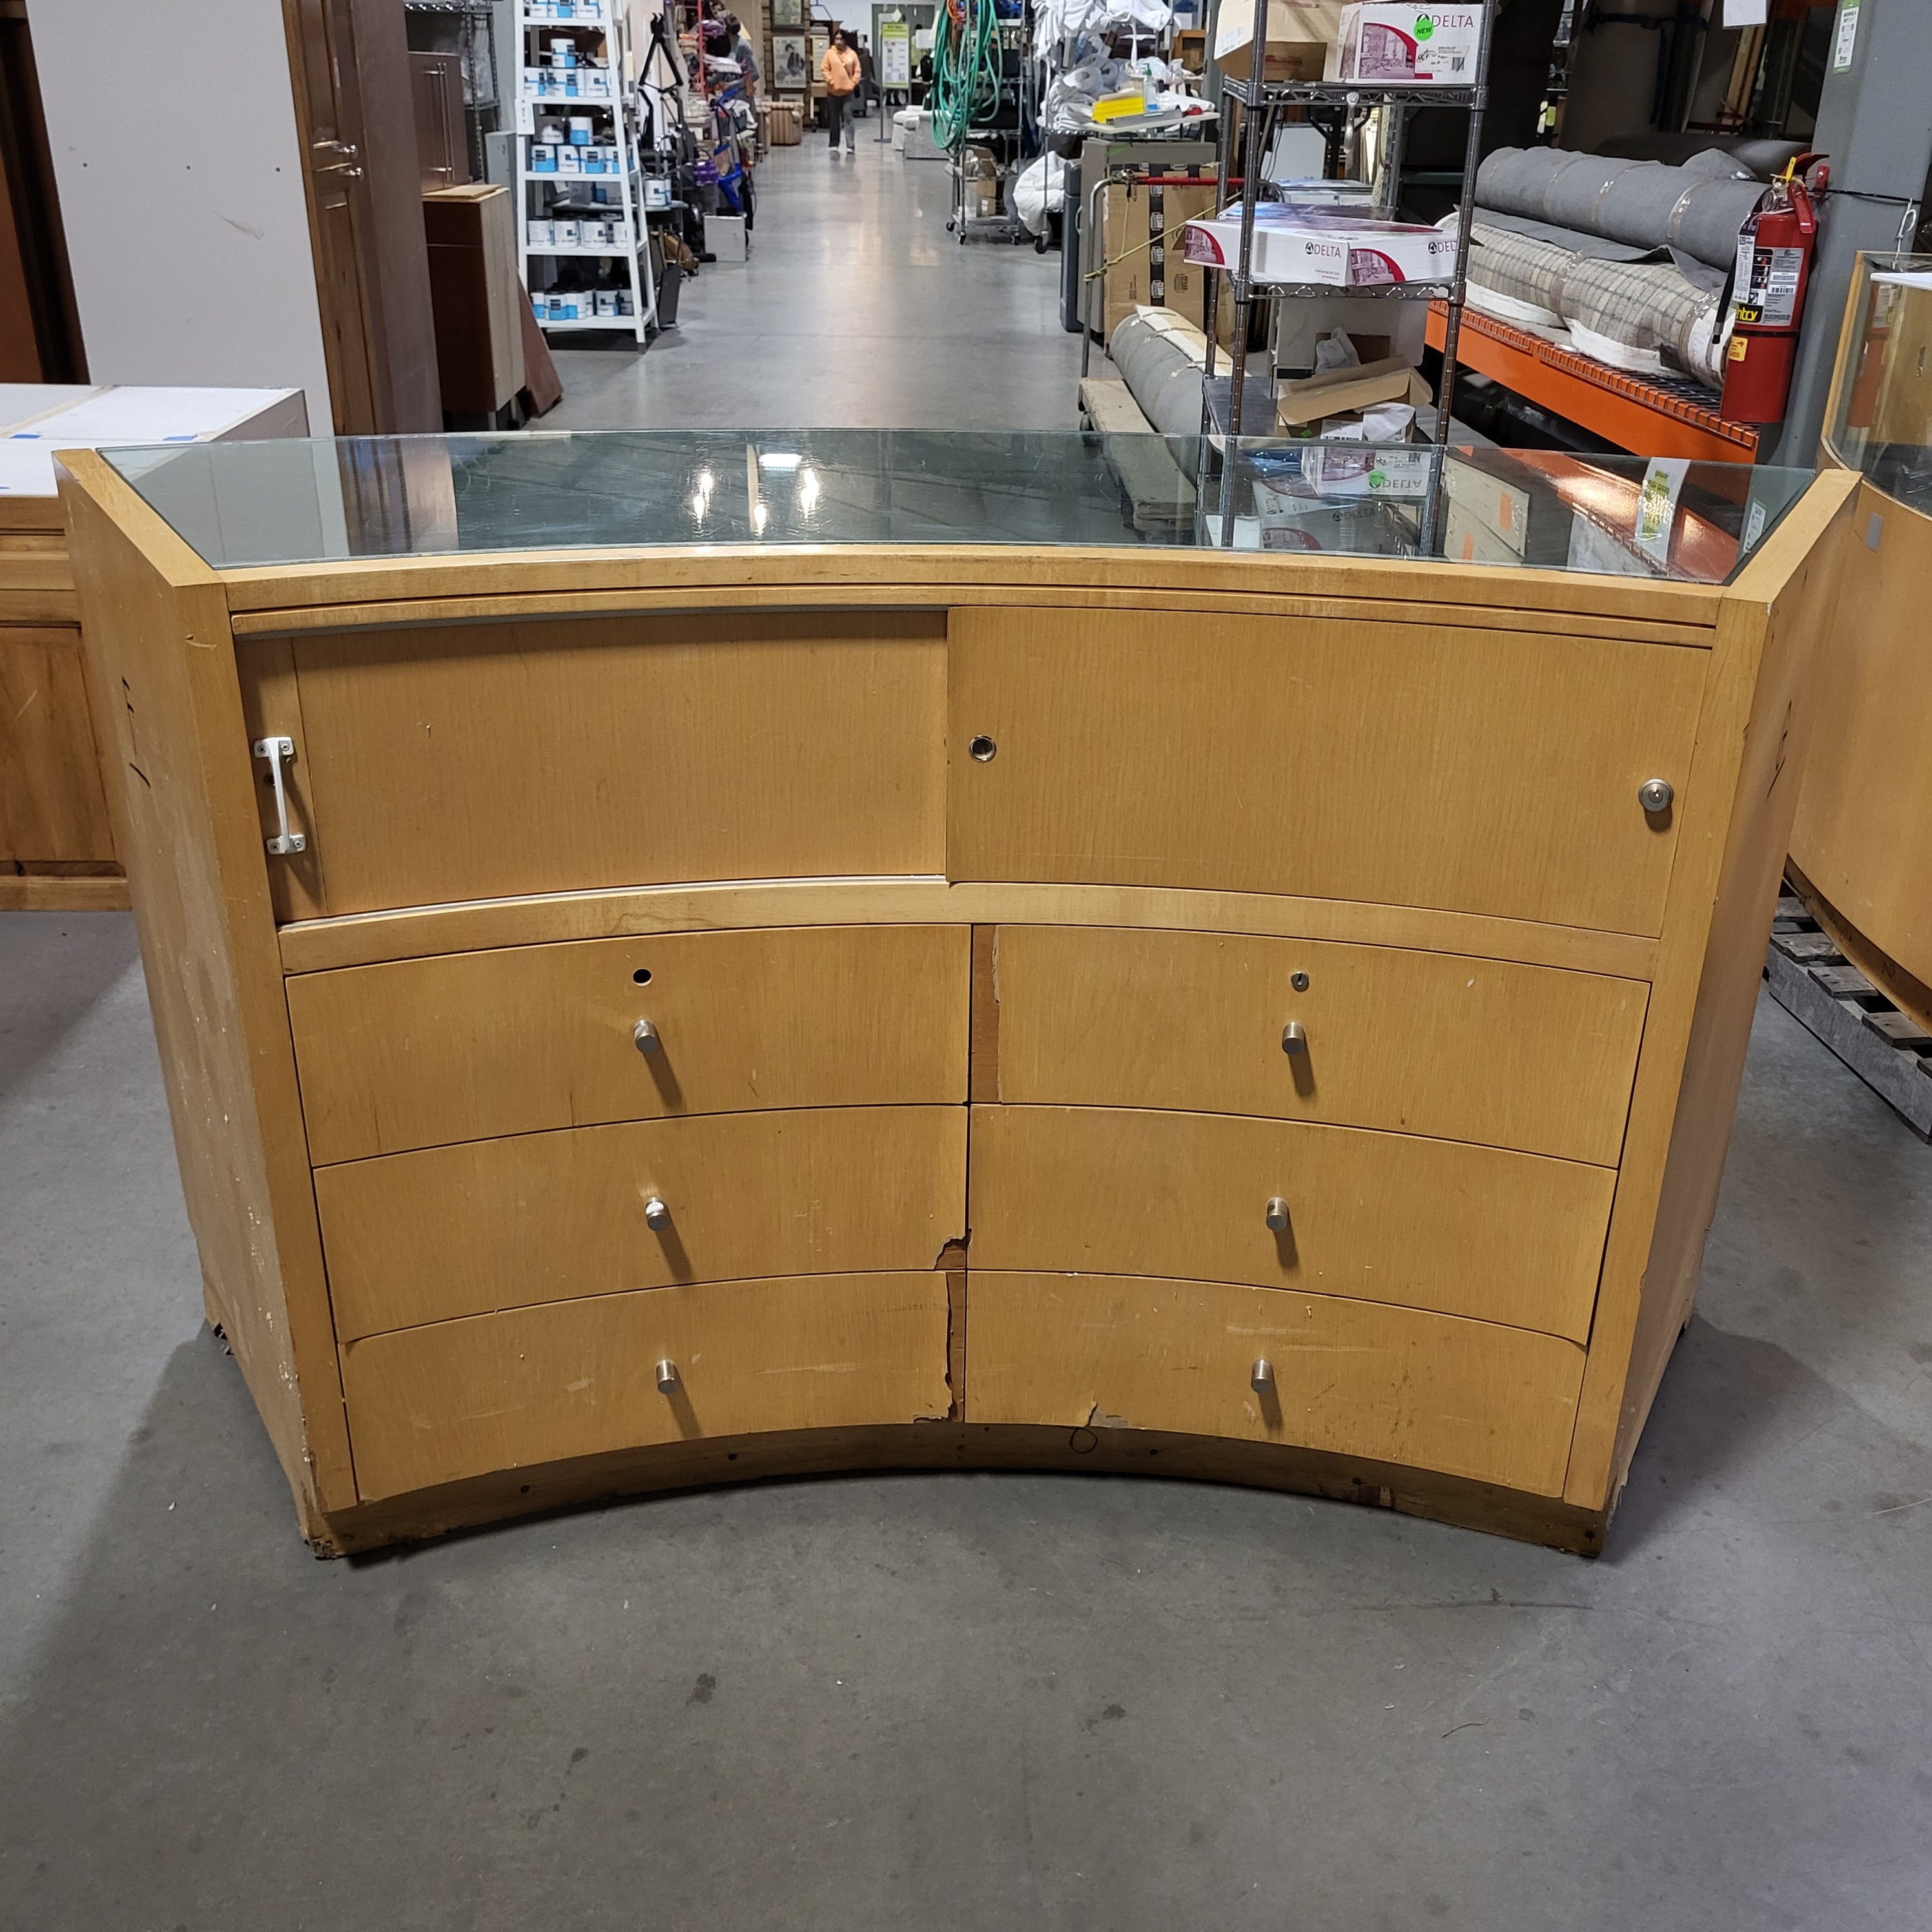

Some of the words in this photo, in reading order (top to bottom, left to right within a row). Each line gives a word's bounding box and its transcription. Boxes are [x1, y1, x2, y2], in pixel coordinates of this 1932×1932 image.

[1432, 15, 1474, 27] DELTA
[1314, 244, 1341, 258] DELTA
[1437, 241, 1457, 252] DEL
[1736, 307, 1758, 321] ntry
